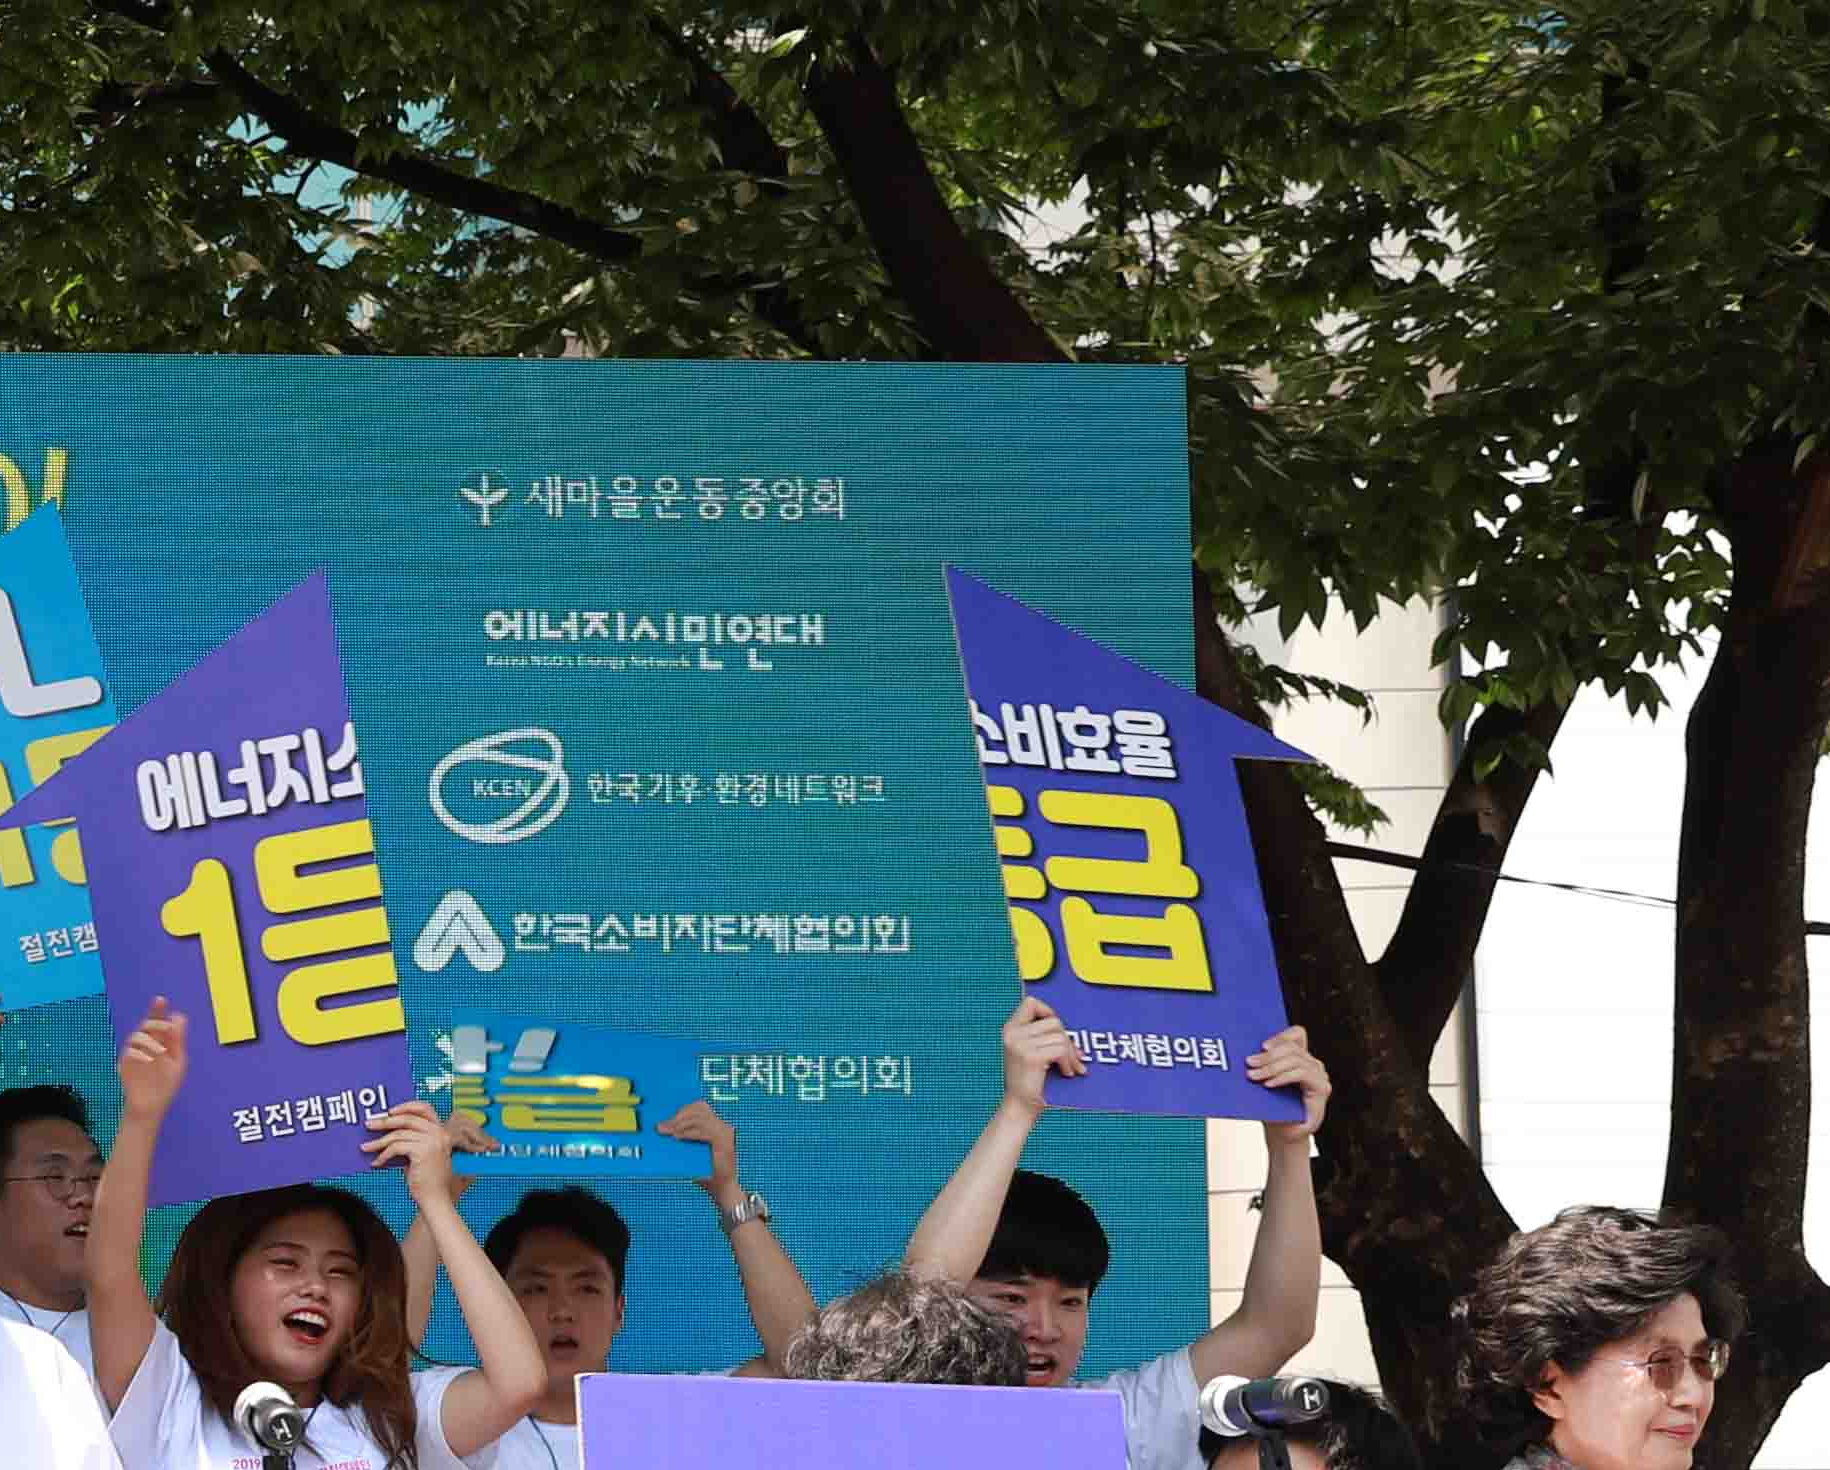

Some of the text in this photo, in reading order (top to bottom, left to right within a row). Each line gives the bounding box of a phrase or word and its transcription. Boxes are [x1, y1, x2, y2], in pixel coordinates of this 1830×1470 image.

[524, 476, 844, 520] 새마을운동중앙회
[484, 609, 826, 670] 에너지시민연대
[473, 778, 533, 797] KCEN
[513, 913, 911, 953] 한국소비자단체협의회
[700, 1053, 913, 1102] 단체협의회
[232, 1086, 390, 1145] 절전캠페인
[233, 1458, 262, 1470] 2019
